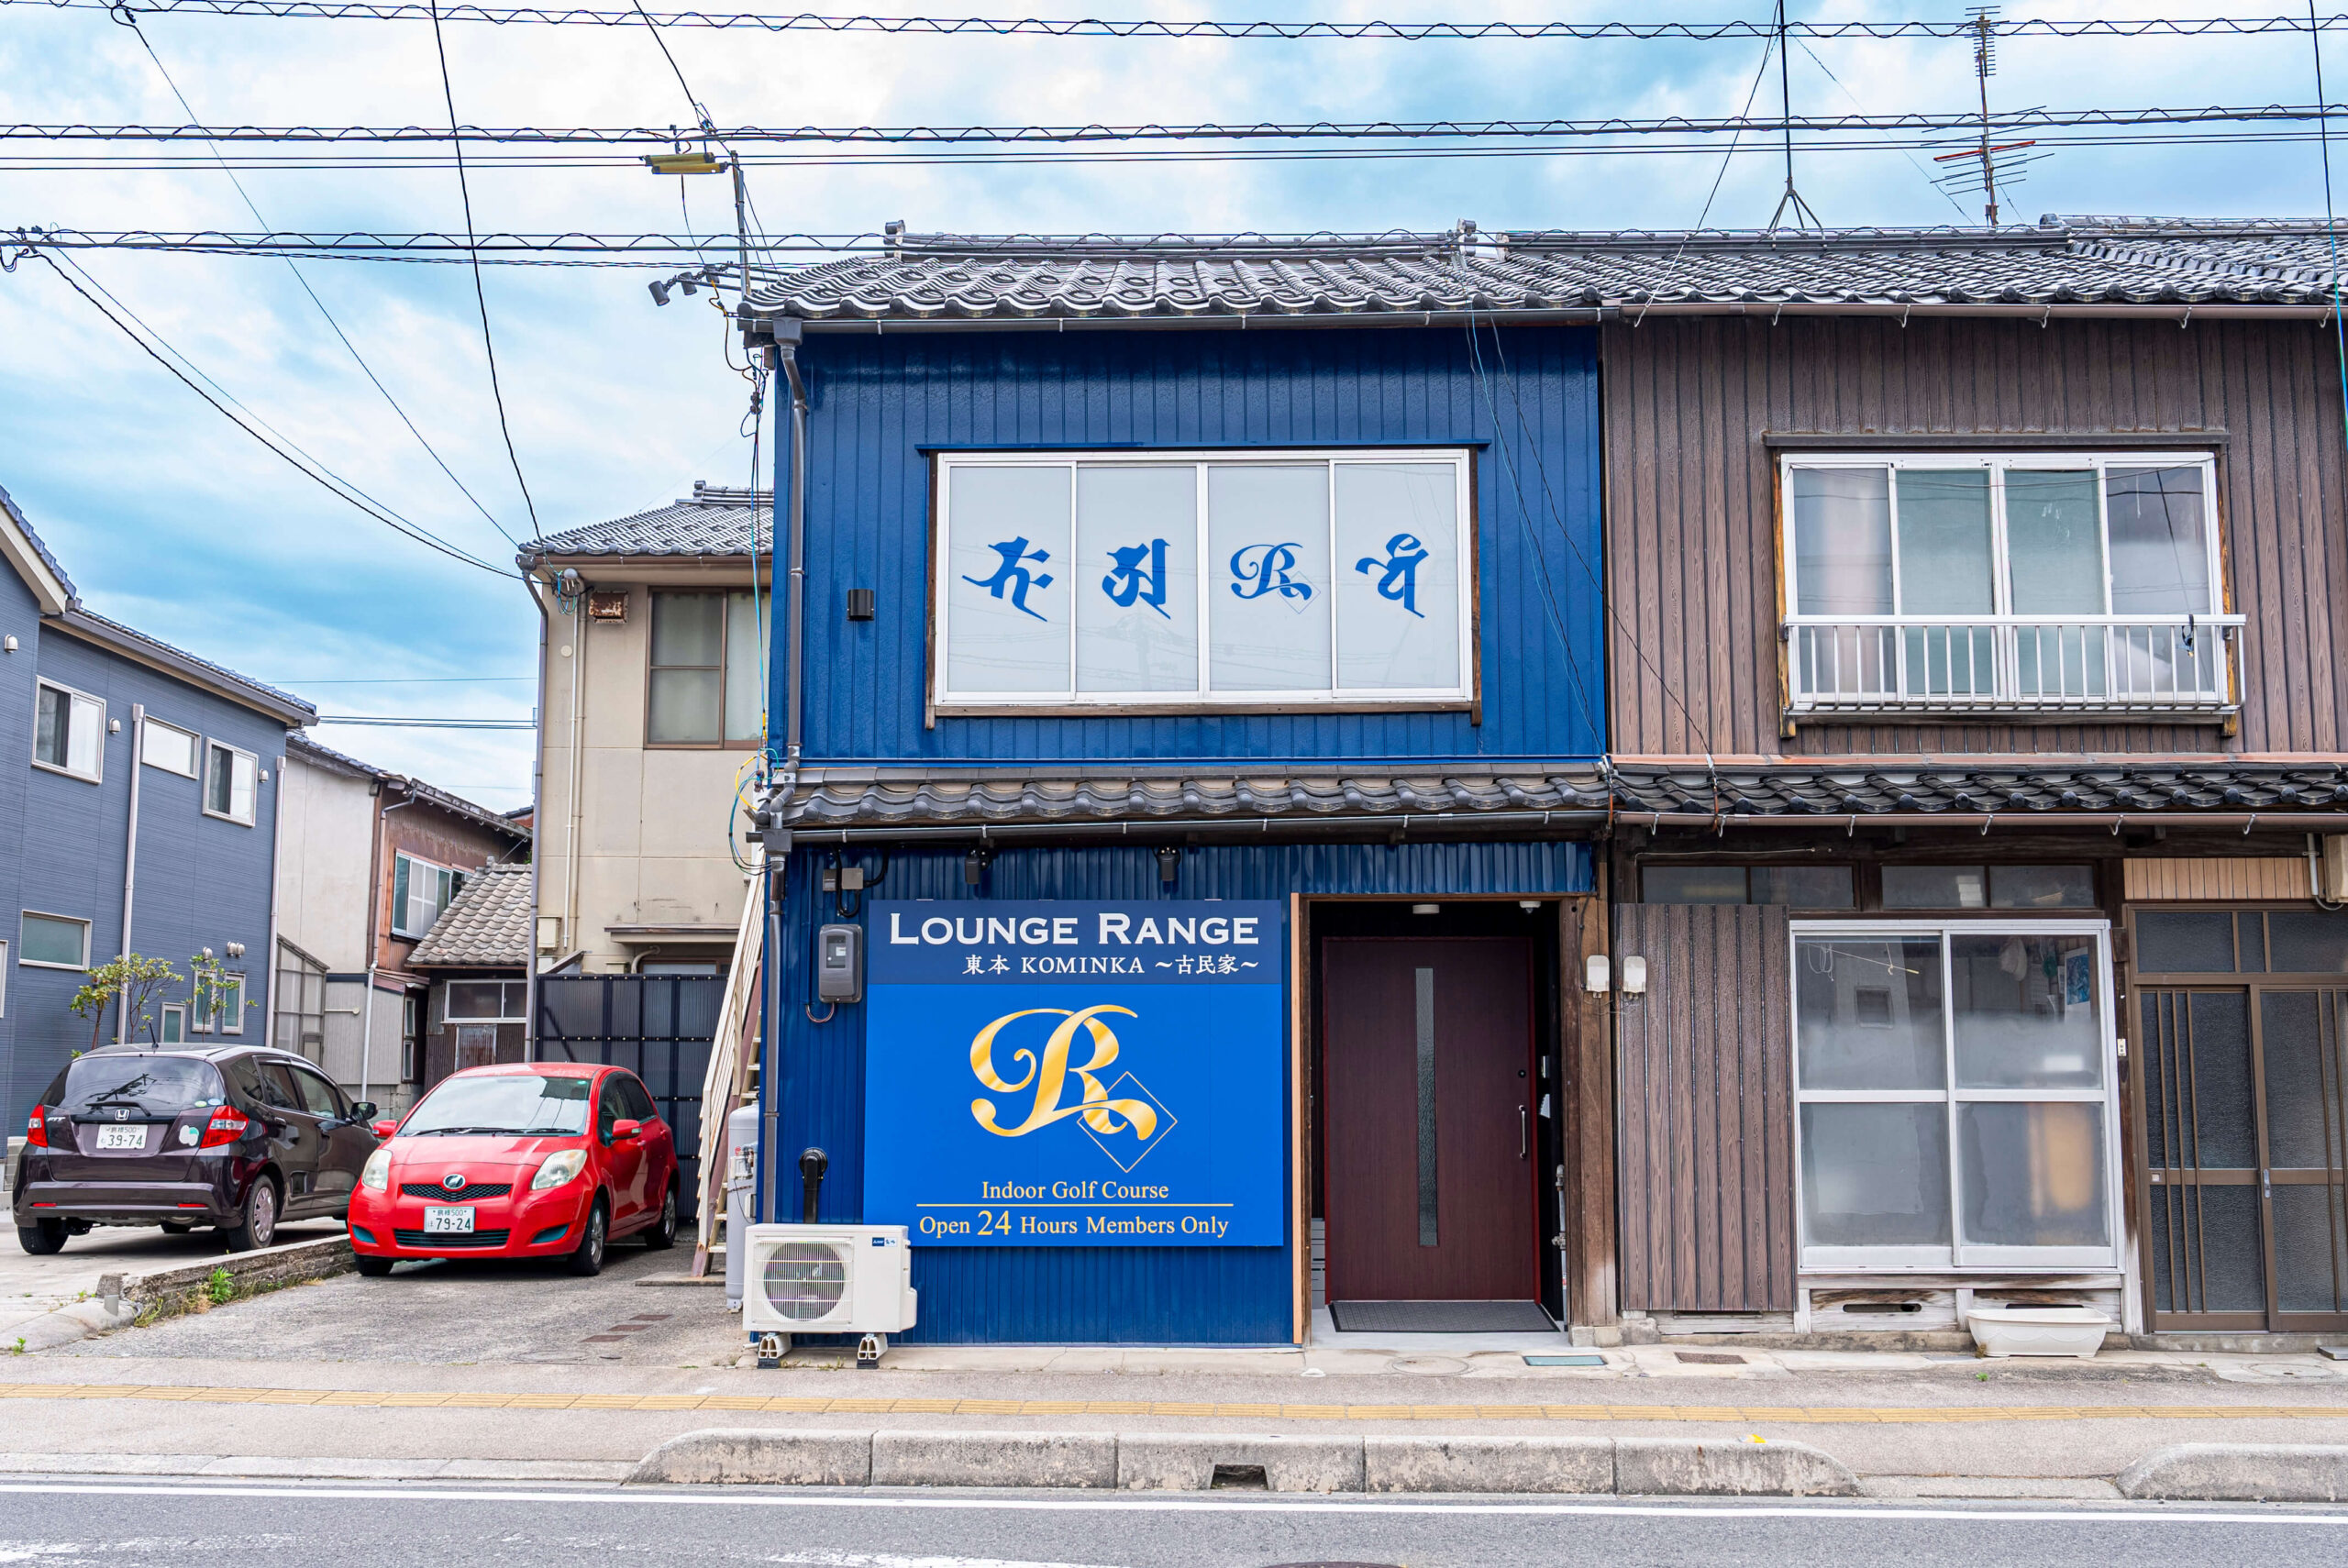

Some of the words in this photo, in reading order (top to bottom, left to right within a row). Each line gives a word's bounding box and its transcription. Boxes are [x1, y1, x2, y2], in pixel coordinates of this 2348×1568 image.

[1021, 956, 1146, 974] KOMINKA
[107, 1134, 143, 1146] 39-74
[982, 1180, 1047, 1199] Indoor
[1051, 1180, 1098, 1199] Golf
[1102, 1181, 1169, 1199] Course
[436, 1218, 471, 1231] 79-24
[919, 1216, 970, 1239] Open
[977, 1209, 1012, 1236] 24
[1020, 1216, 1079, 1234] Hours
[1086, 1215, 1176, 1234] Members
[1180, 1215, 1229, 1239] Only
